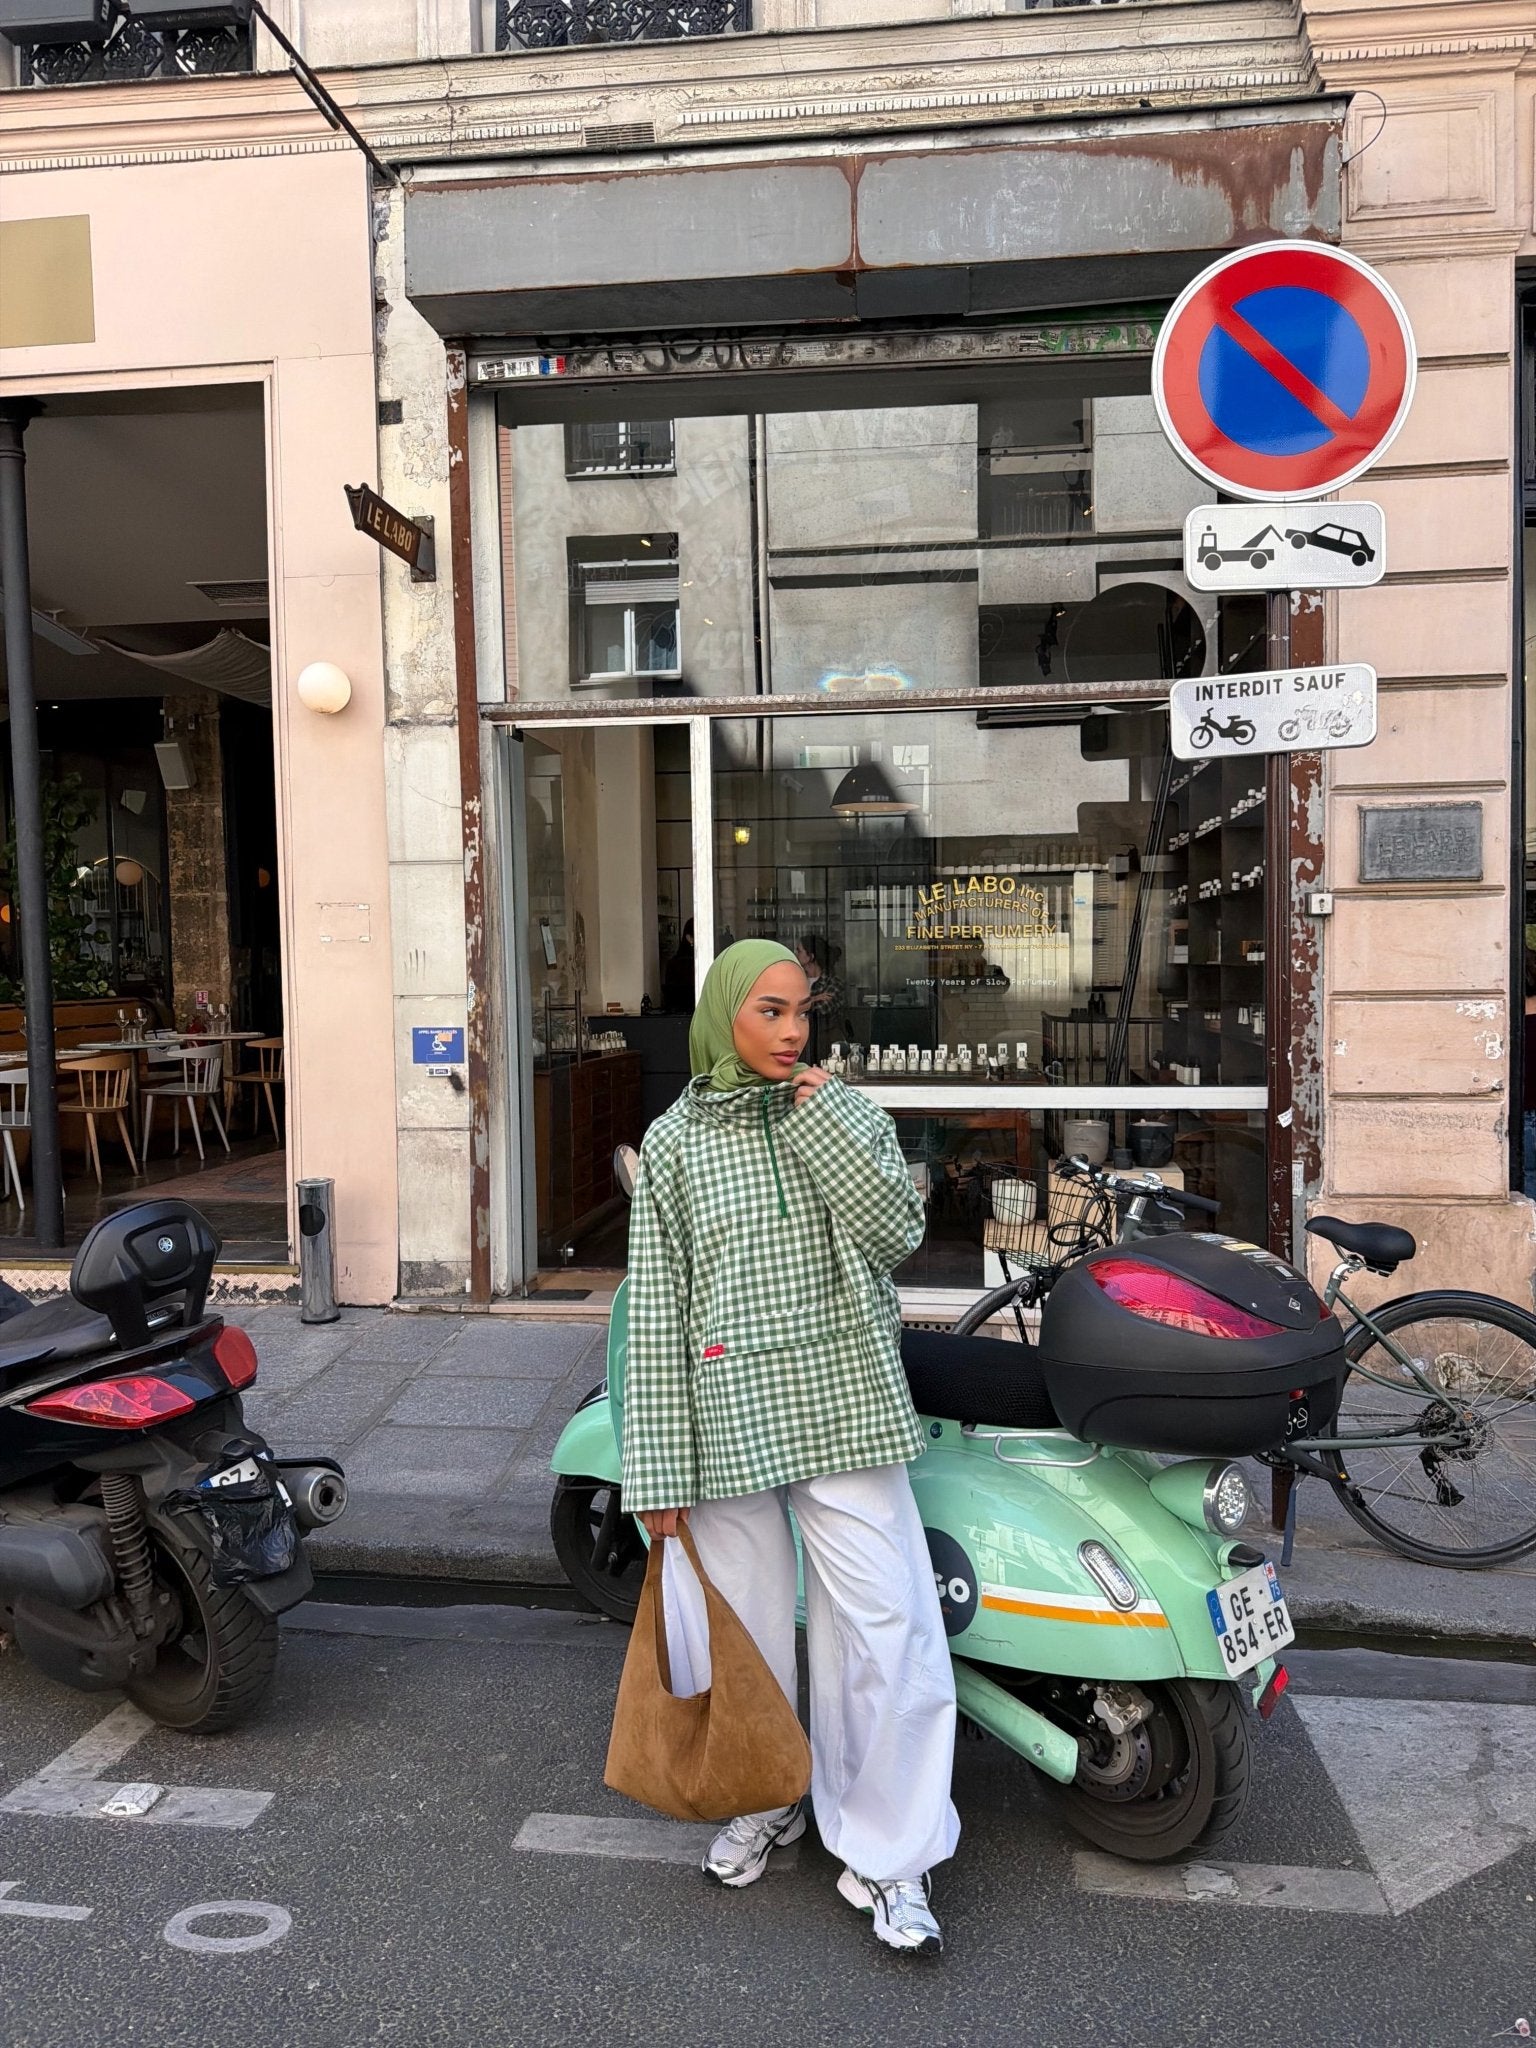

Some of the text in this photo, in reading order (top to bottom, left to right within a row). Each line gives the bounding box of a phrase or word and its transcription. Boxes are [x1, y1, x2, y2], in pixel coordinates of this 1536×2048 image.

[366, 501, 413, 552] LE LABO
[1195, 672, 1346, 701] INTERDIT SAUF
[918, 876, 1046, 905] LE LABO Inc.
[914, 898, 1050, 922] MANUFACTURERS OF
[907, 924, 1057, 939] FINE PERFUMERY
[906, 978, 936, 987] Twenty
[940, 978, 966, 986] Years
[970, 978, 980, 986] of
[985, 978, 1007, 986] Slow
[1270, 1581, 1281, 1596] 75
